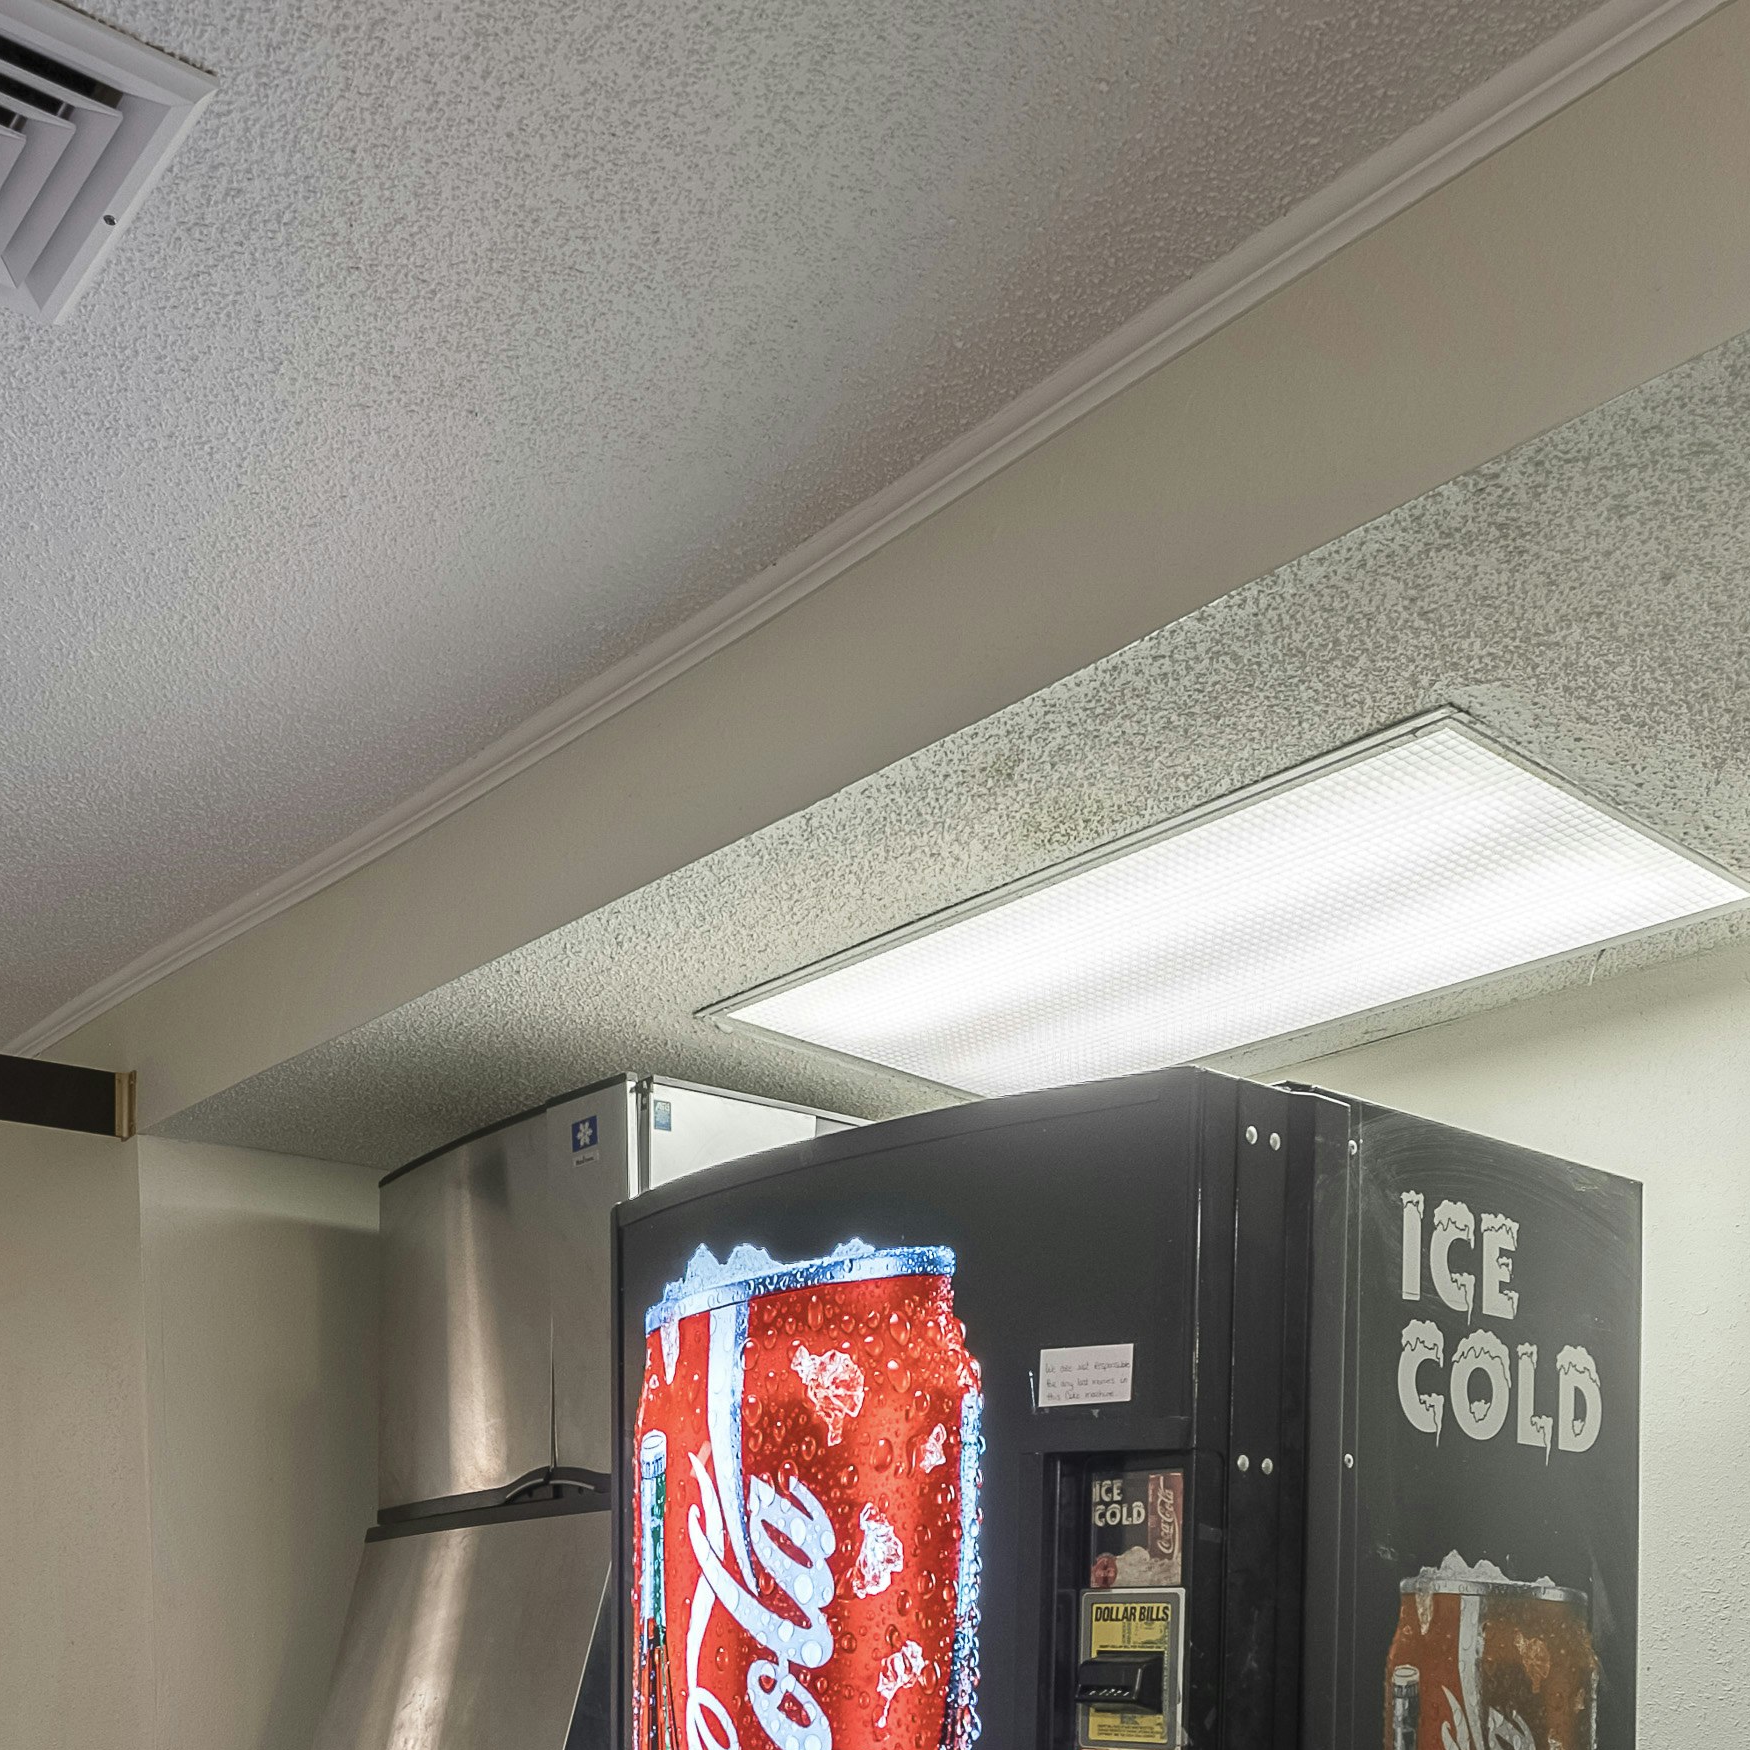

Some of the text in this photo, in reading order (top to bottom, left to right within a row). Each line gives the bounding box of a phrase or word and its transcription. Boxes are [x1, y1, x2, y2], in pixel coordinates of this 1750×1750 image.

[1401, 1190, 1519, 1325] ICE
[1398, 1318, 1602, 1466] COLD
[1093, 1480, 1124, 1502] ICE
[1094, 1501, 1146, 1527] COLD
[1095, 1606, 1170, 1622] DOLLAR BILLS
